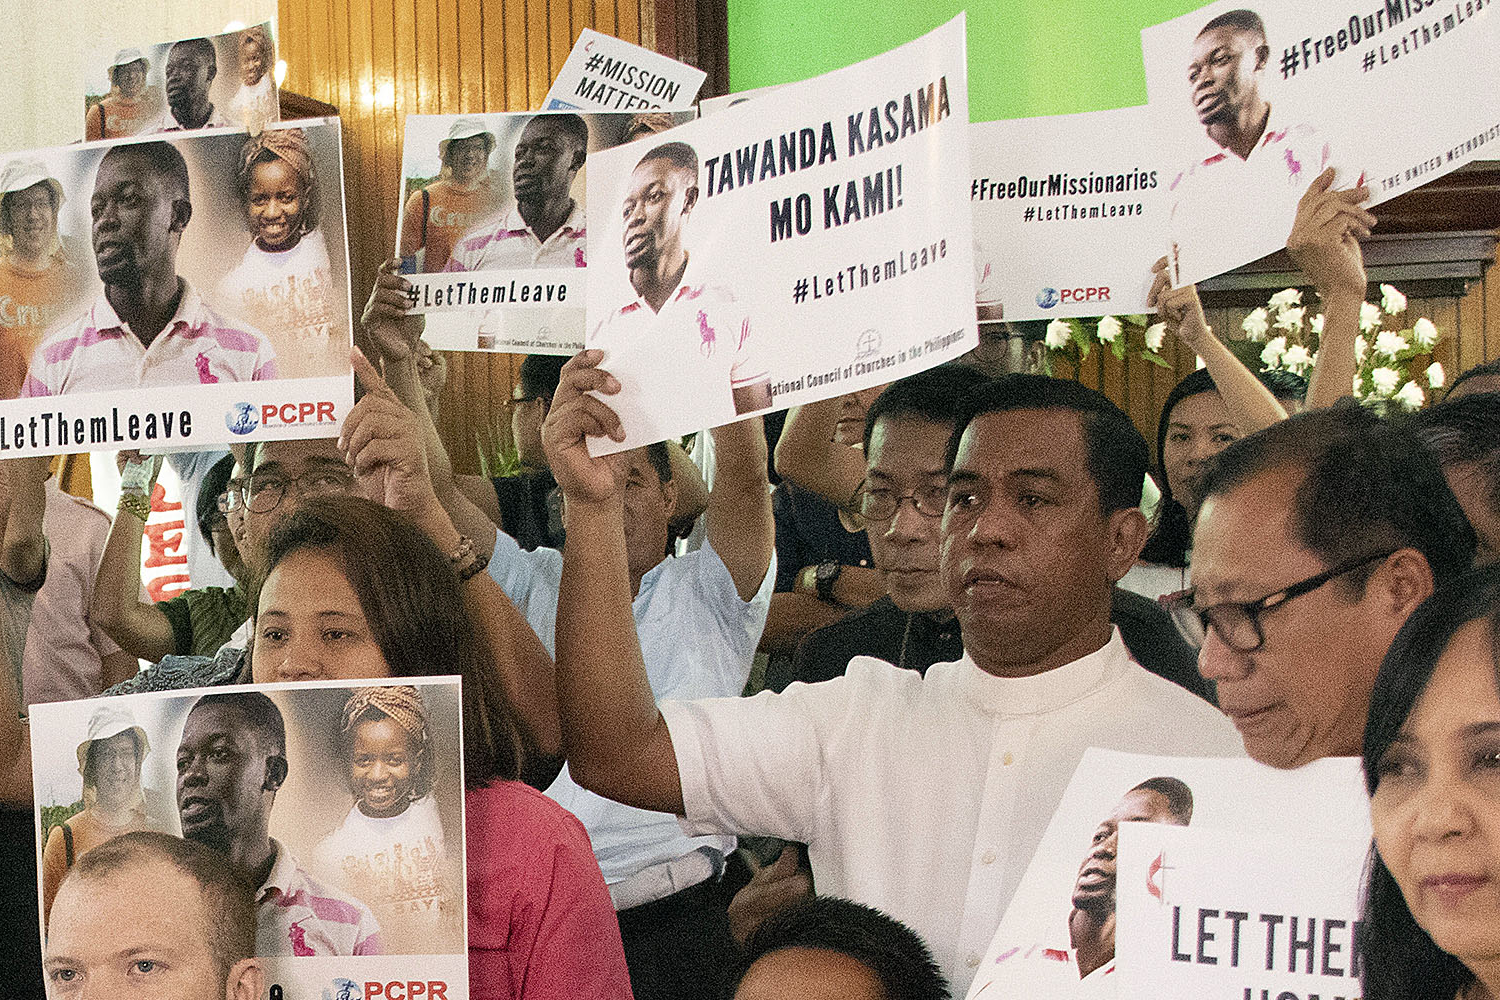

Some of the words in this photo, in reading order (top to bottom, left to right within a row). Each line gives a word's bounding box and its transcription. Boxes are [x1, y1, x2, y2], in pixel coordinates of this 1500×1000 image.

[584, 53, 681, 103] #MISSION
[703, 120, 838, 198] TAWANDA
[847, 75, 951, 154] KASAMA
[770, 193, 811, 244] MO
[823, 163, 904, 228] KAMI!
[1023, 202, 1143, 222] #LetThemLeave
[407, 280, 567, 308] #LetThemLeave
[792, 235, 948, 304] #LetThemLeave
[1060, 286, 1111, 302] PCPR
[262, 401, 337, 424] PCPR
[1170, 905, 1249, 968] LET
